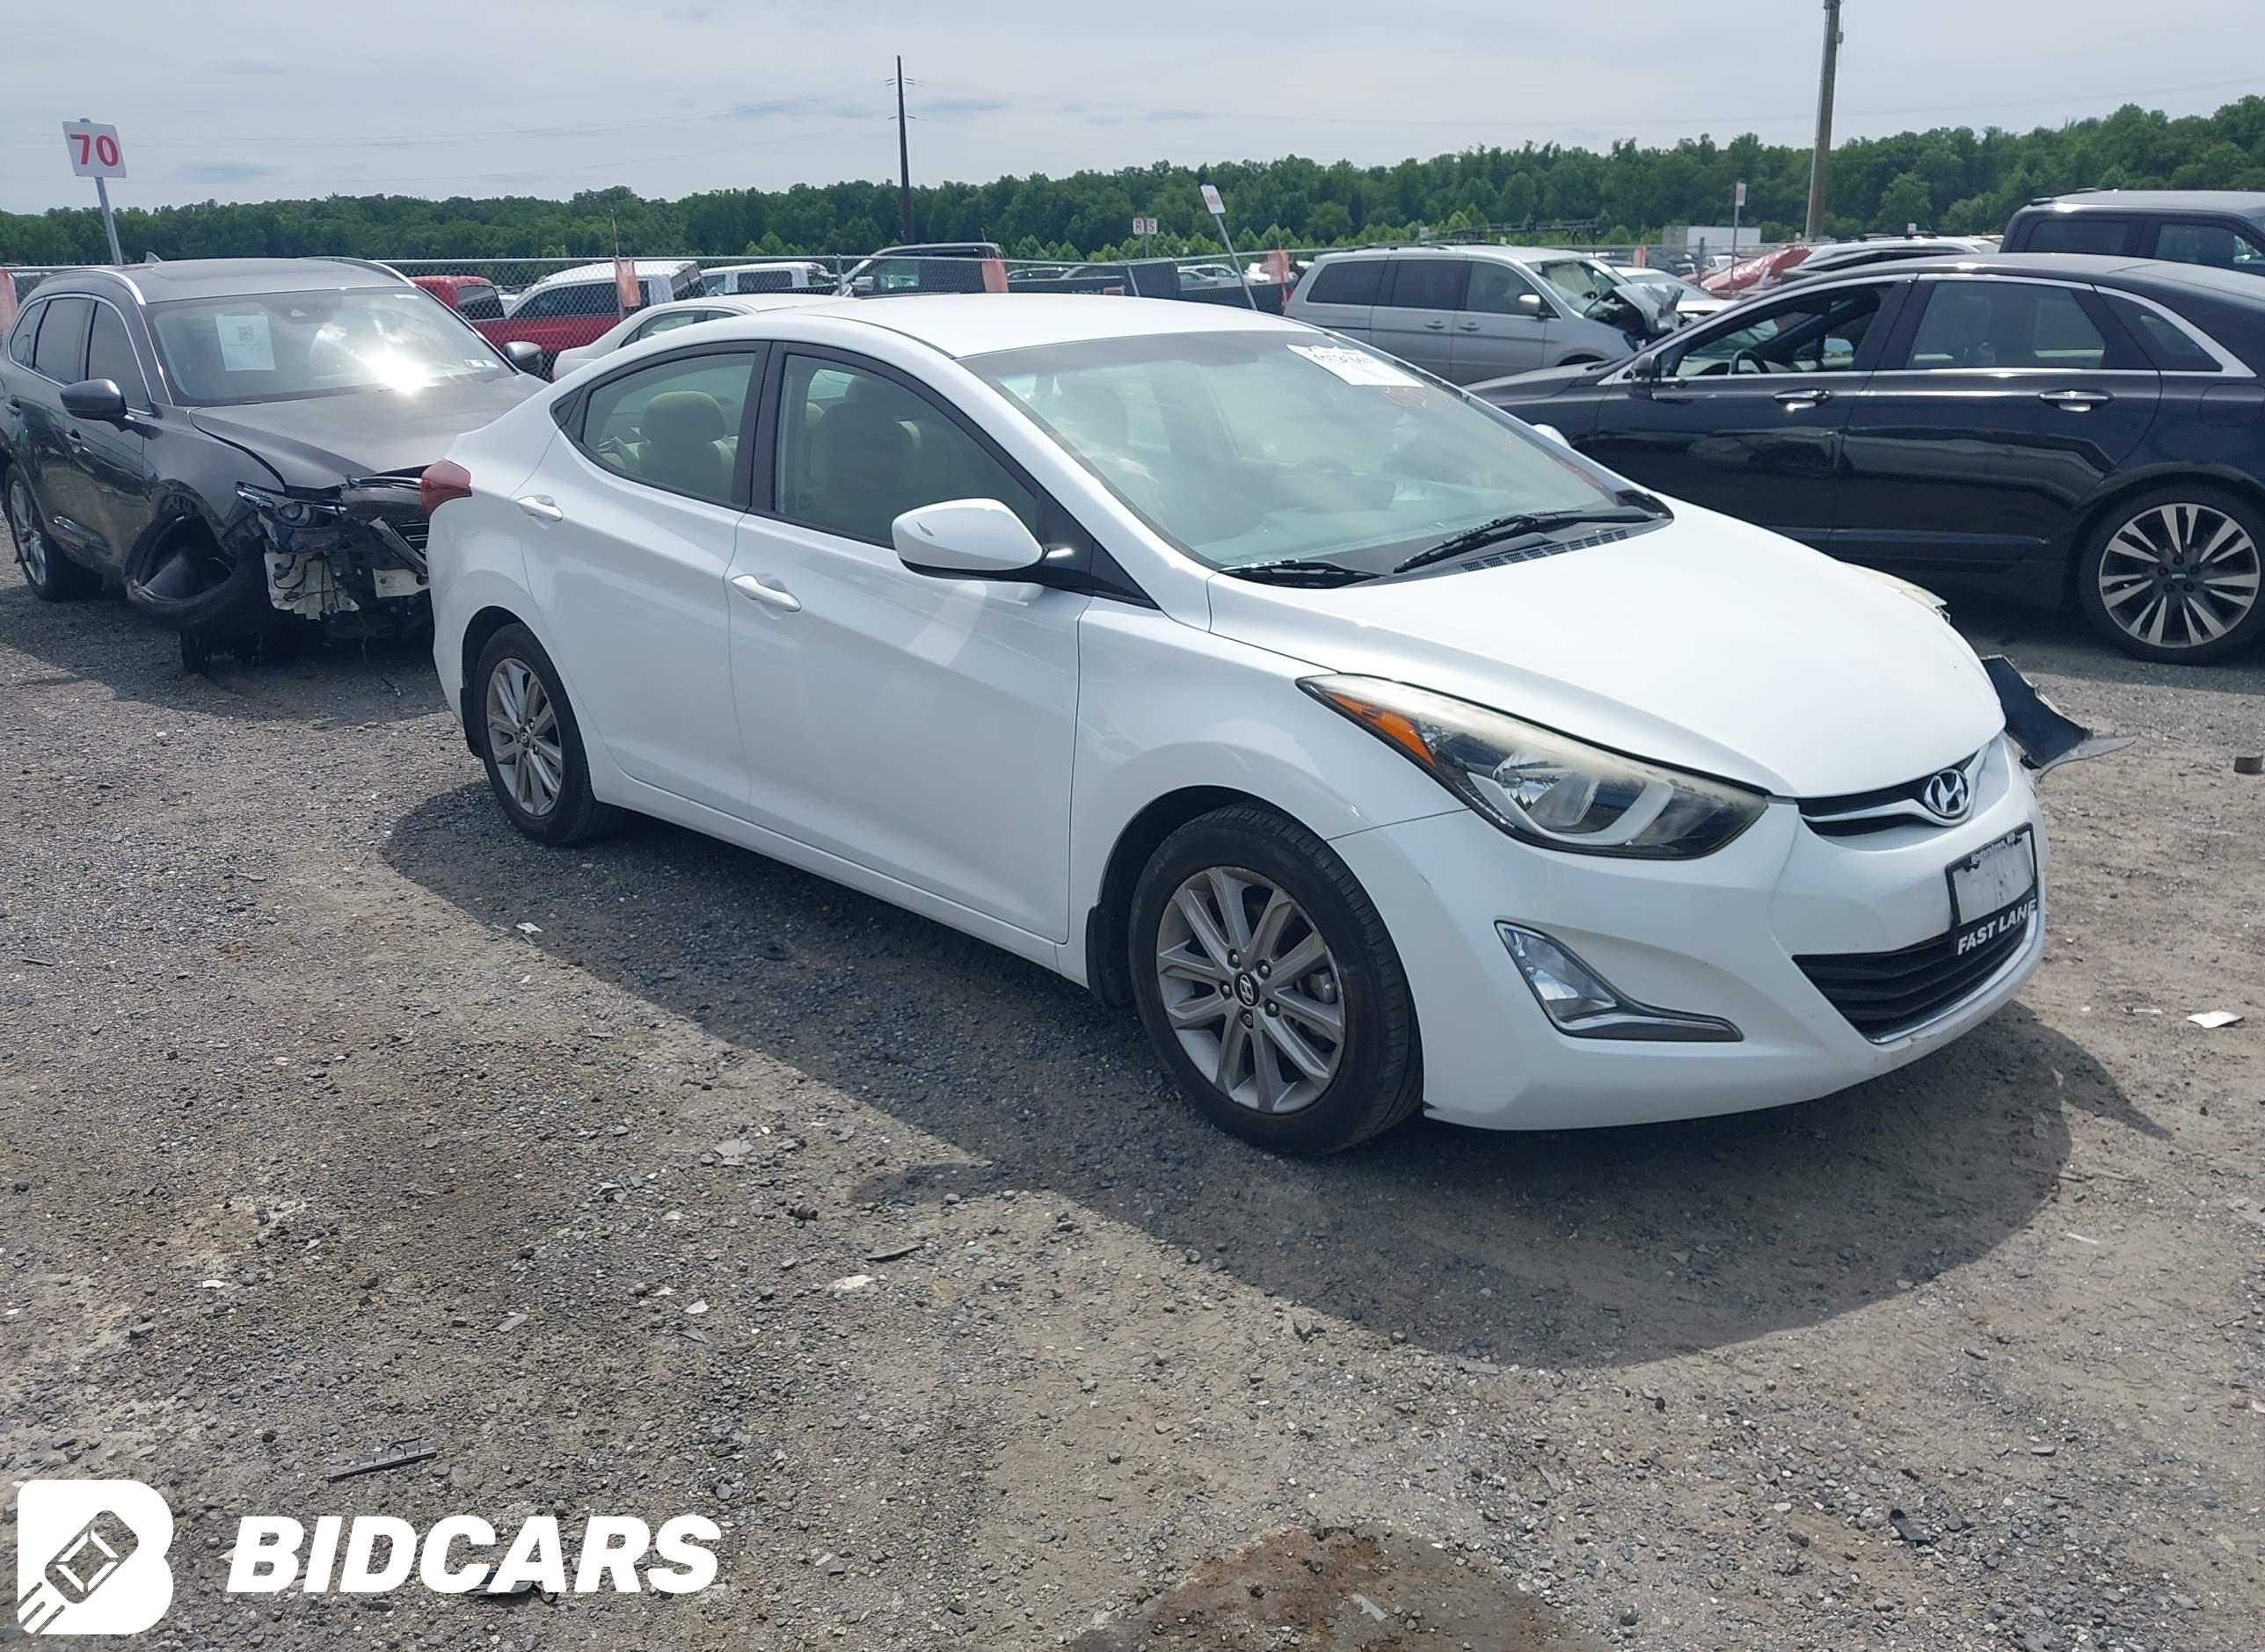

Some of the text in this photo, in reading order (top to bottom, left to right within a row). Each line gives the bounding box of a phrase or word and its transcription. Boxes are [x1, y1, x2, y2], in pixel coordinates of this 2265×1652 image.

[70, 134, 119, 166] 70
[1957, 899, 2037, 956] FAST LANE
